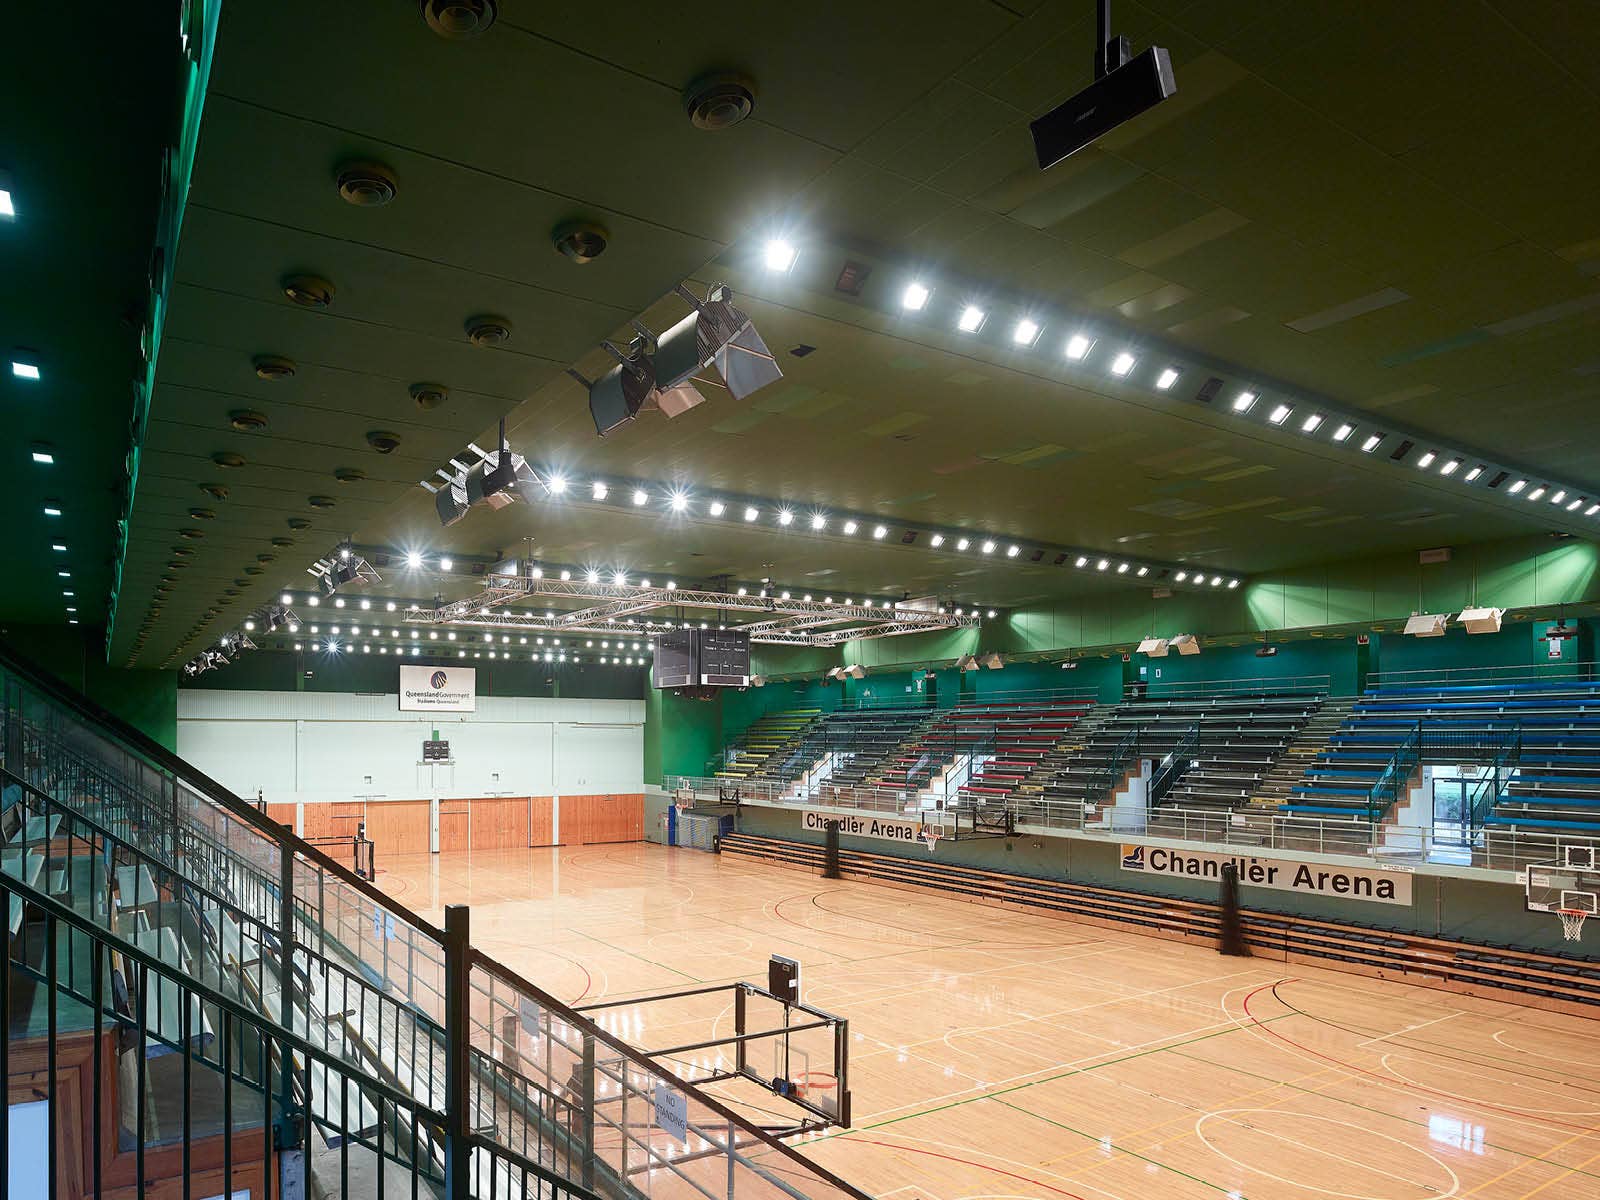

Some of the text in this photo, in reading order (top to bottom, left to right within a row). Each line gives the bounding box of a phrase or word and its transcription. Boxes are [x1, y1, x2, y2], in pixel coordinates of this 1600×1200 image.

[806, 812, 913, 840] Chadler Arena
[1292, 864, 1396, 900] Arena
[665, 1094, 676, 1108] NO
[656, 1103, 685, 1130] STANDING
